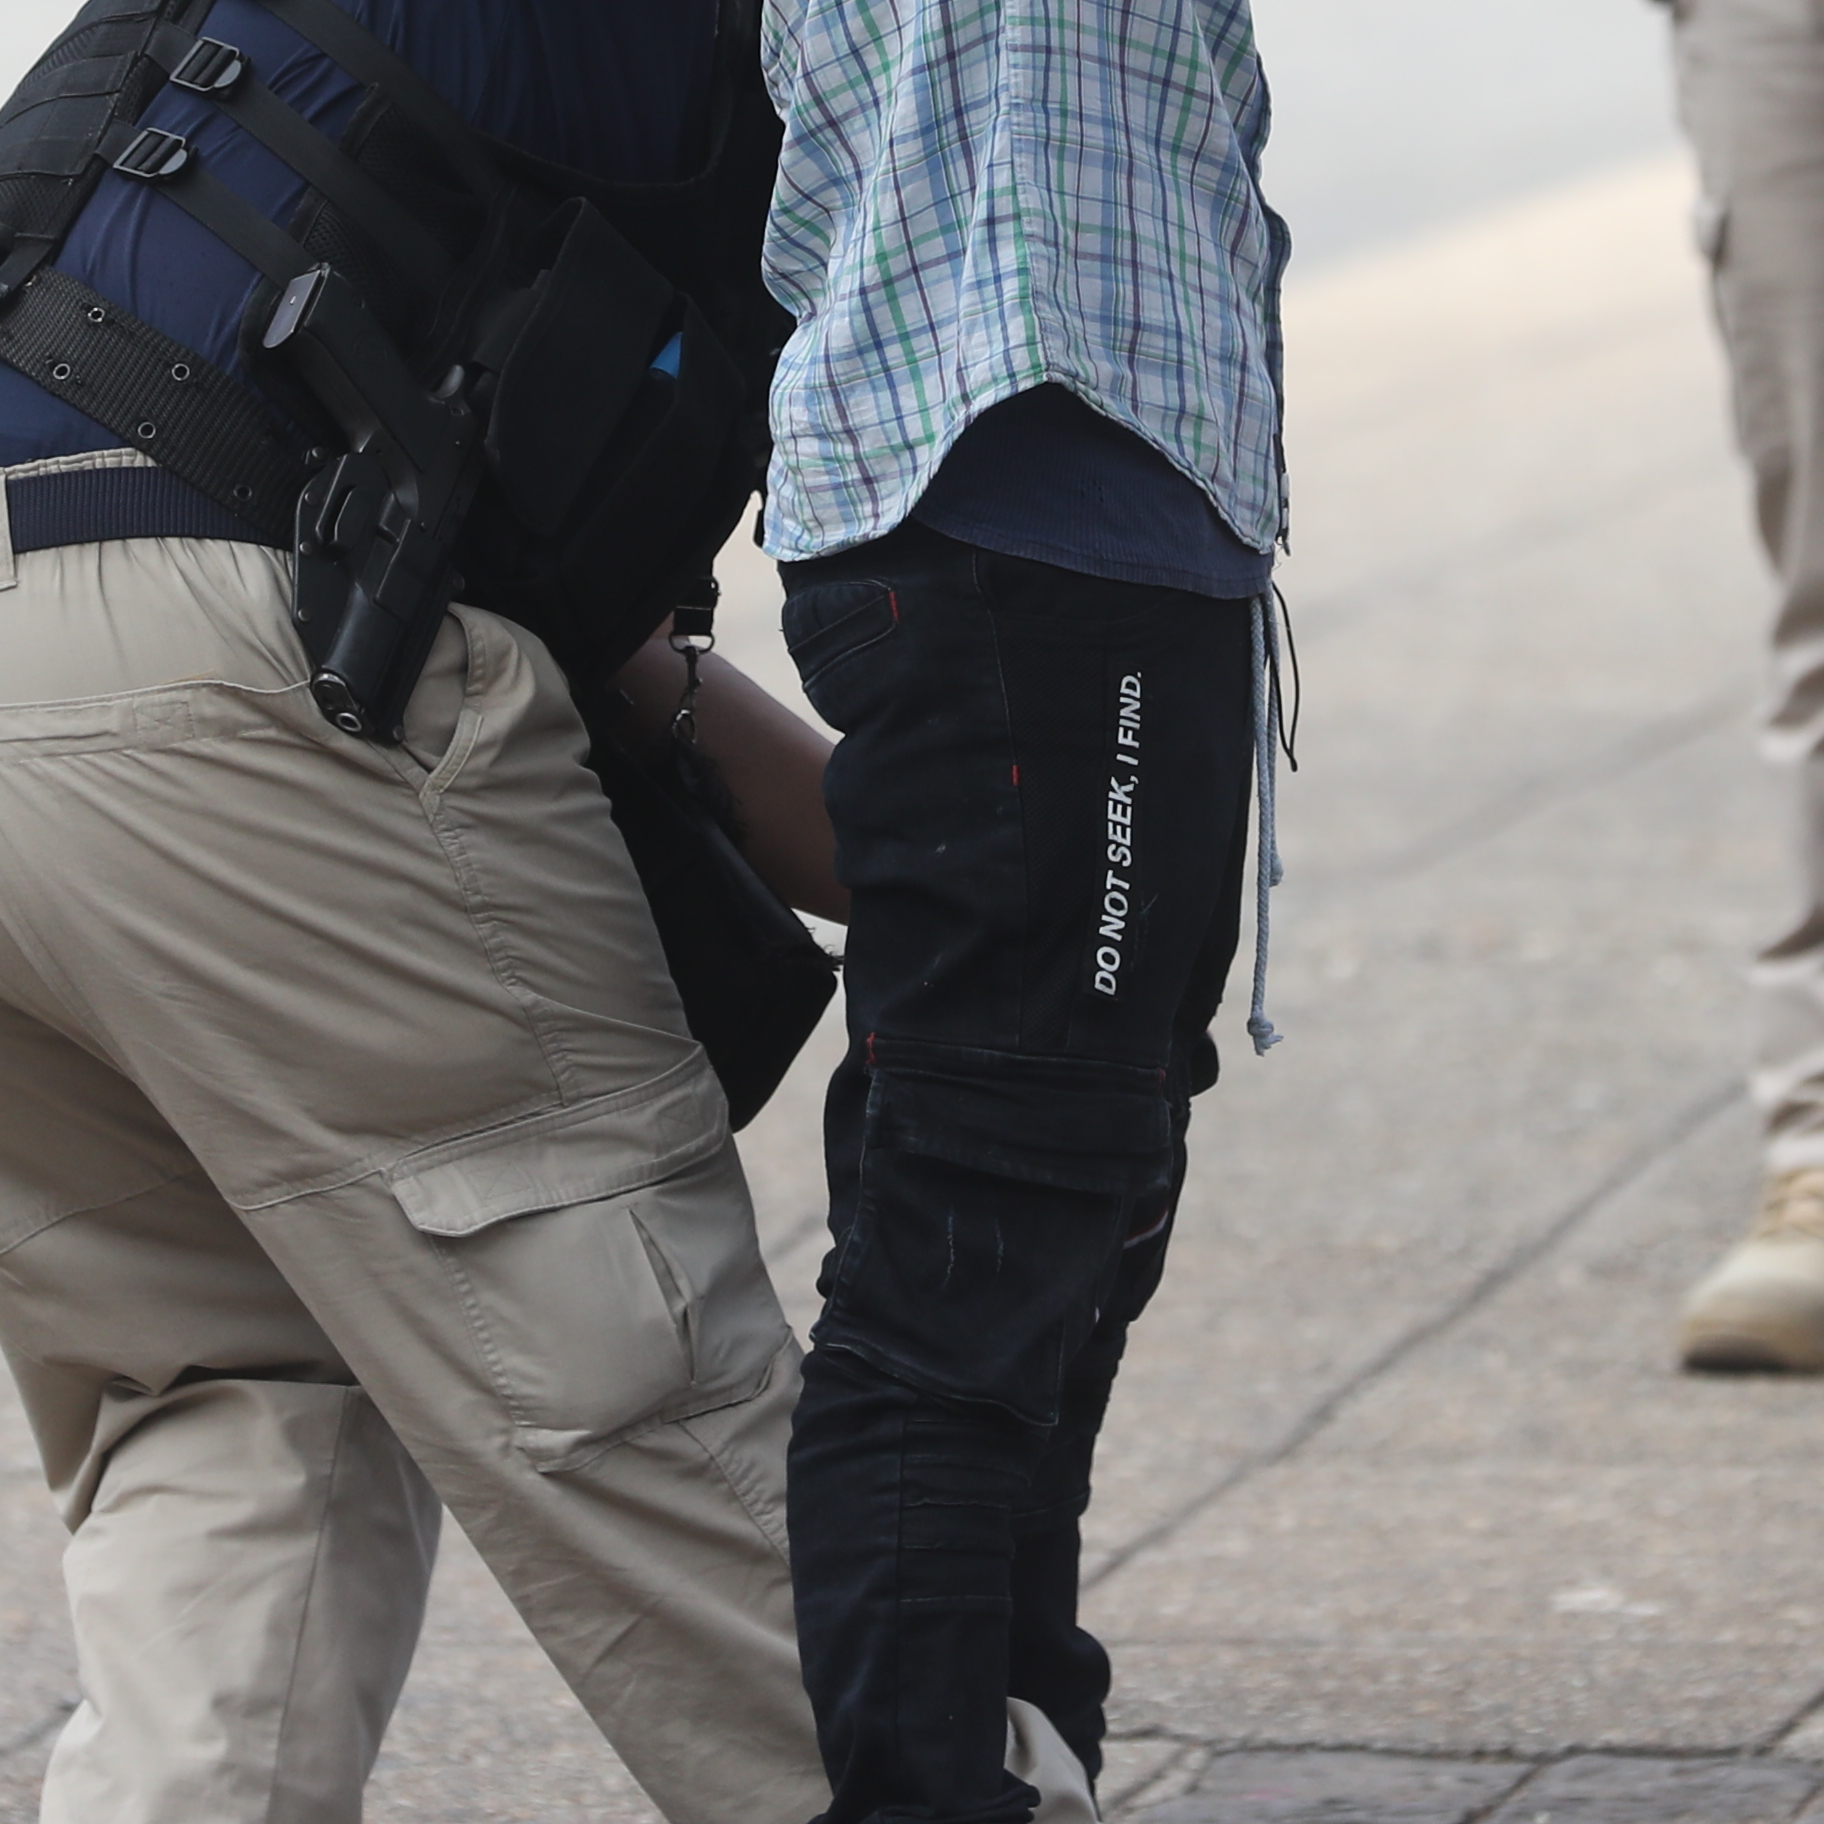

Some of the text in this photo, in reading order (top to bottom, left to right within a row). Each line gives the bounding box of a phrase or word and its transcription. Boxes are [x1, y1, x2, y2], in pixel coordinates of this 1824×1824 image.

[1093, 671, 1142, 997] DO NOT SEEK, I FIND.
